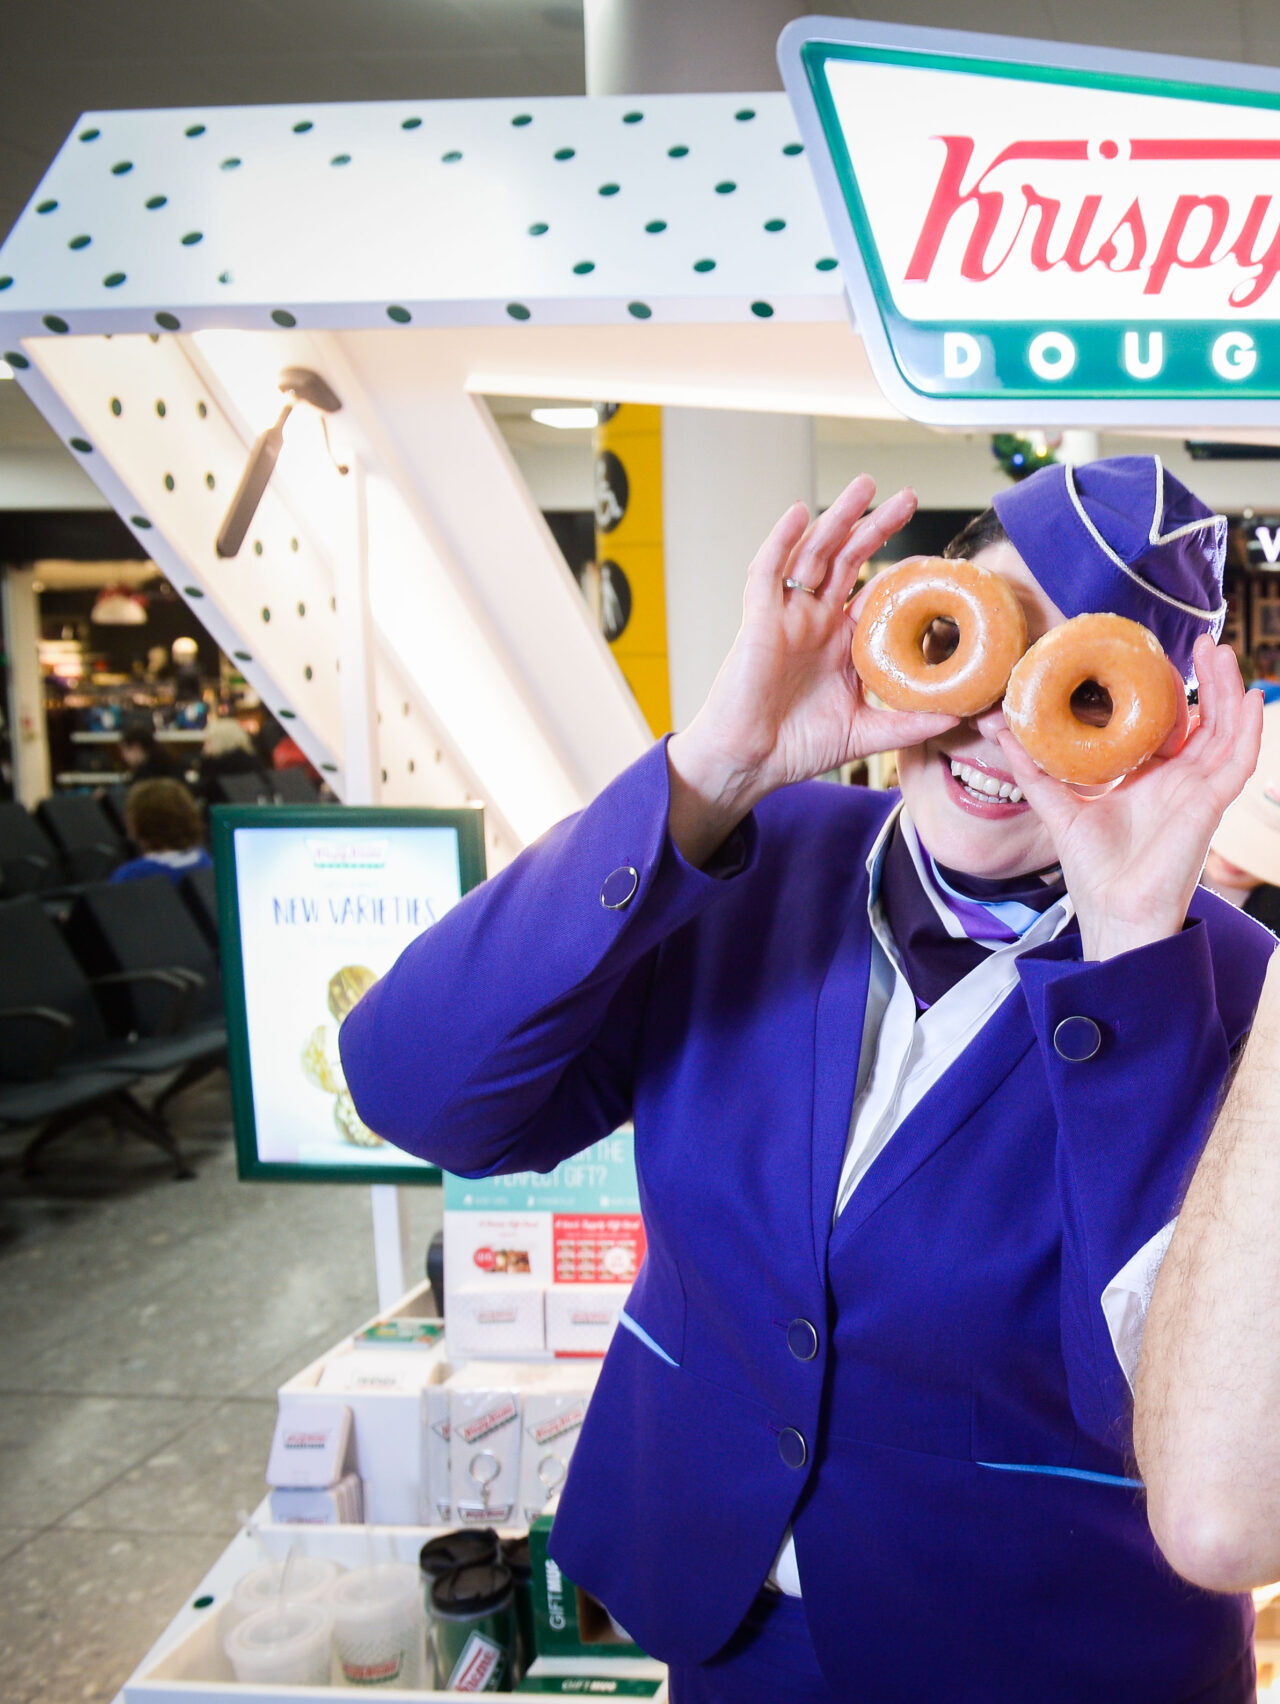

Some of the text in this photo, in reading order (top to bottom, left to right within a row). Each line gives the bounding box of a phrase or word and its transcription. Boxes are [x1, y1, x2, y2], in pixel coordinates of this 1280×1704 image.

[272, 896, 437, 926] NEW VARIETIES
[563, 1165, 607, 1188] GIFT?
[548, 1592, 567, 1630] GIFT
